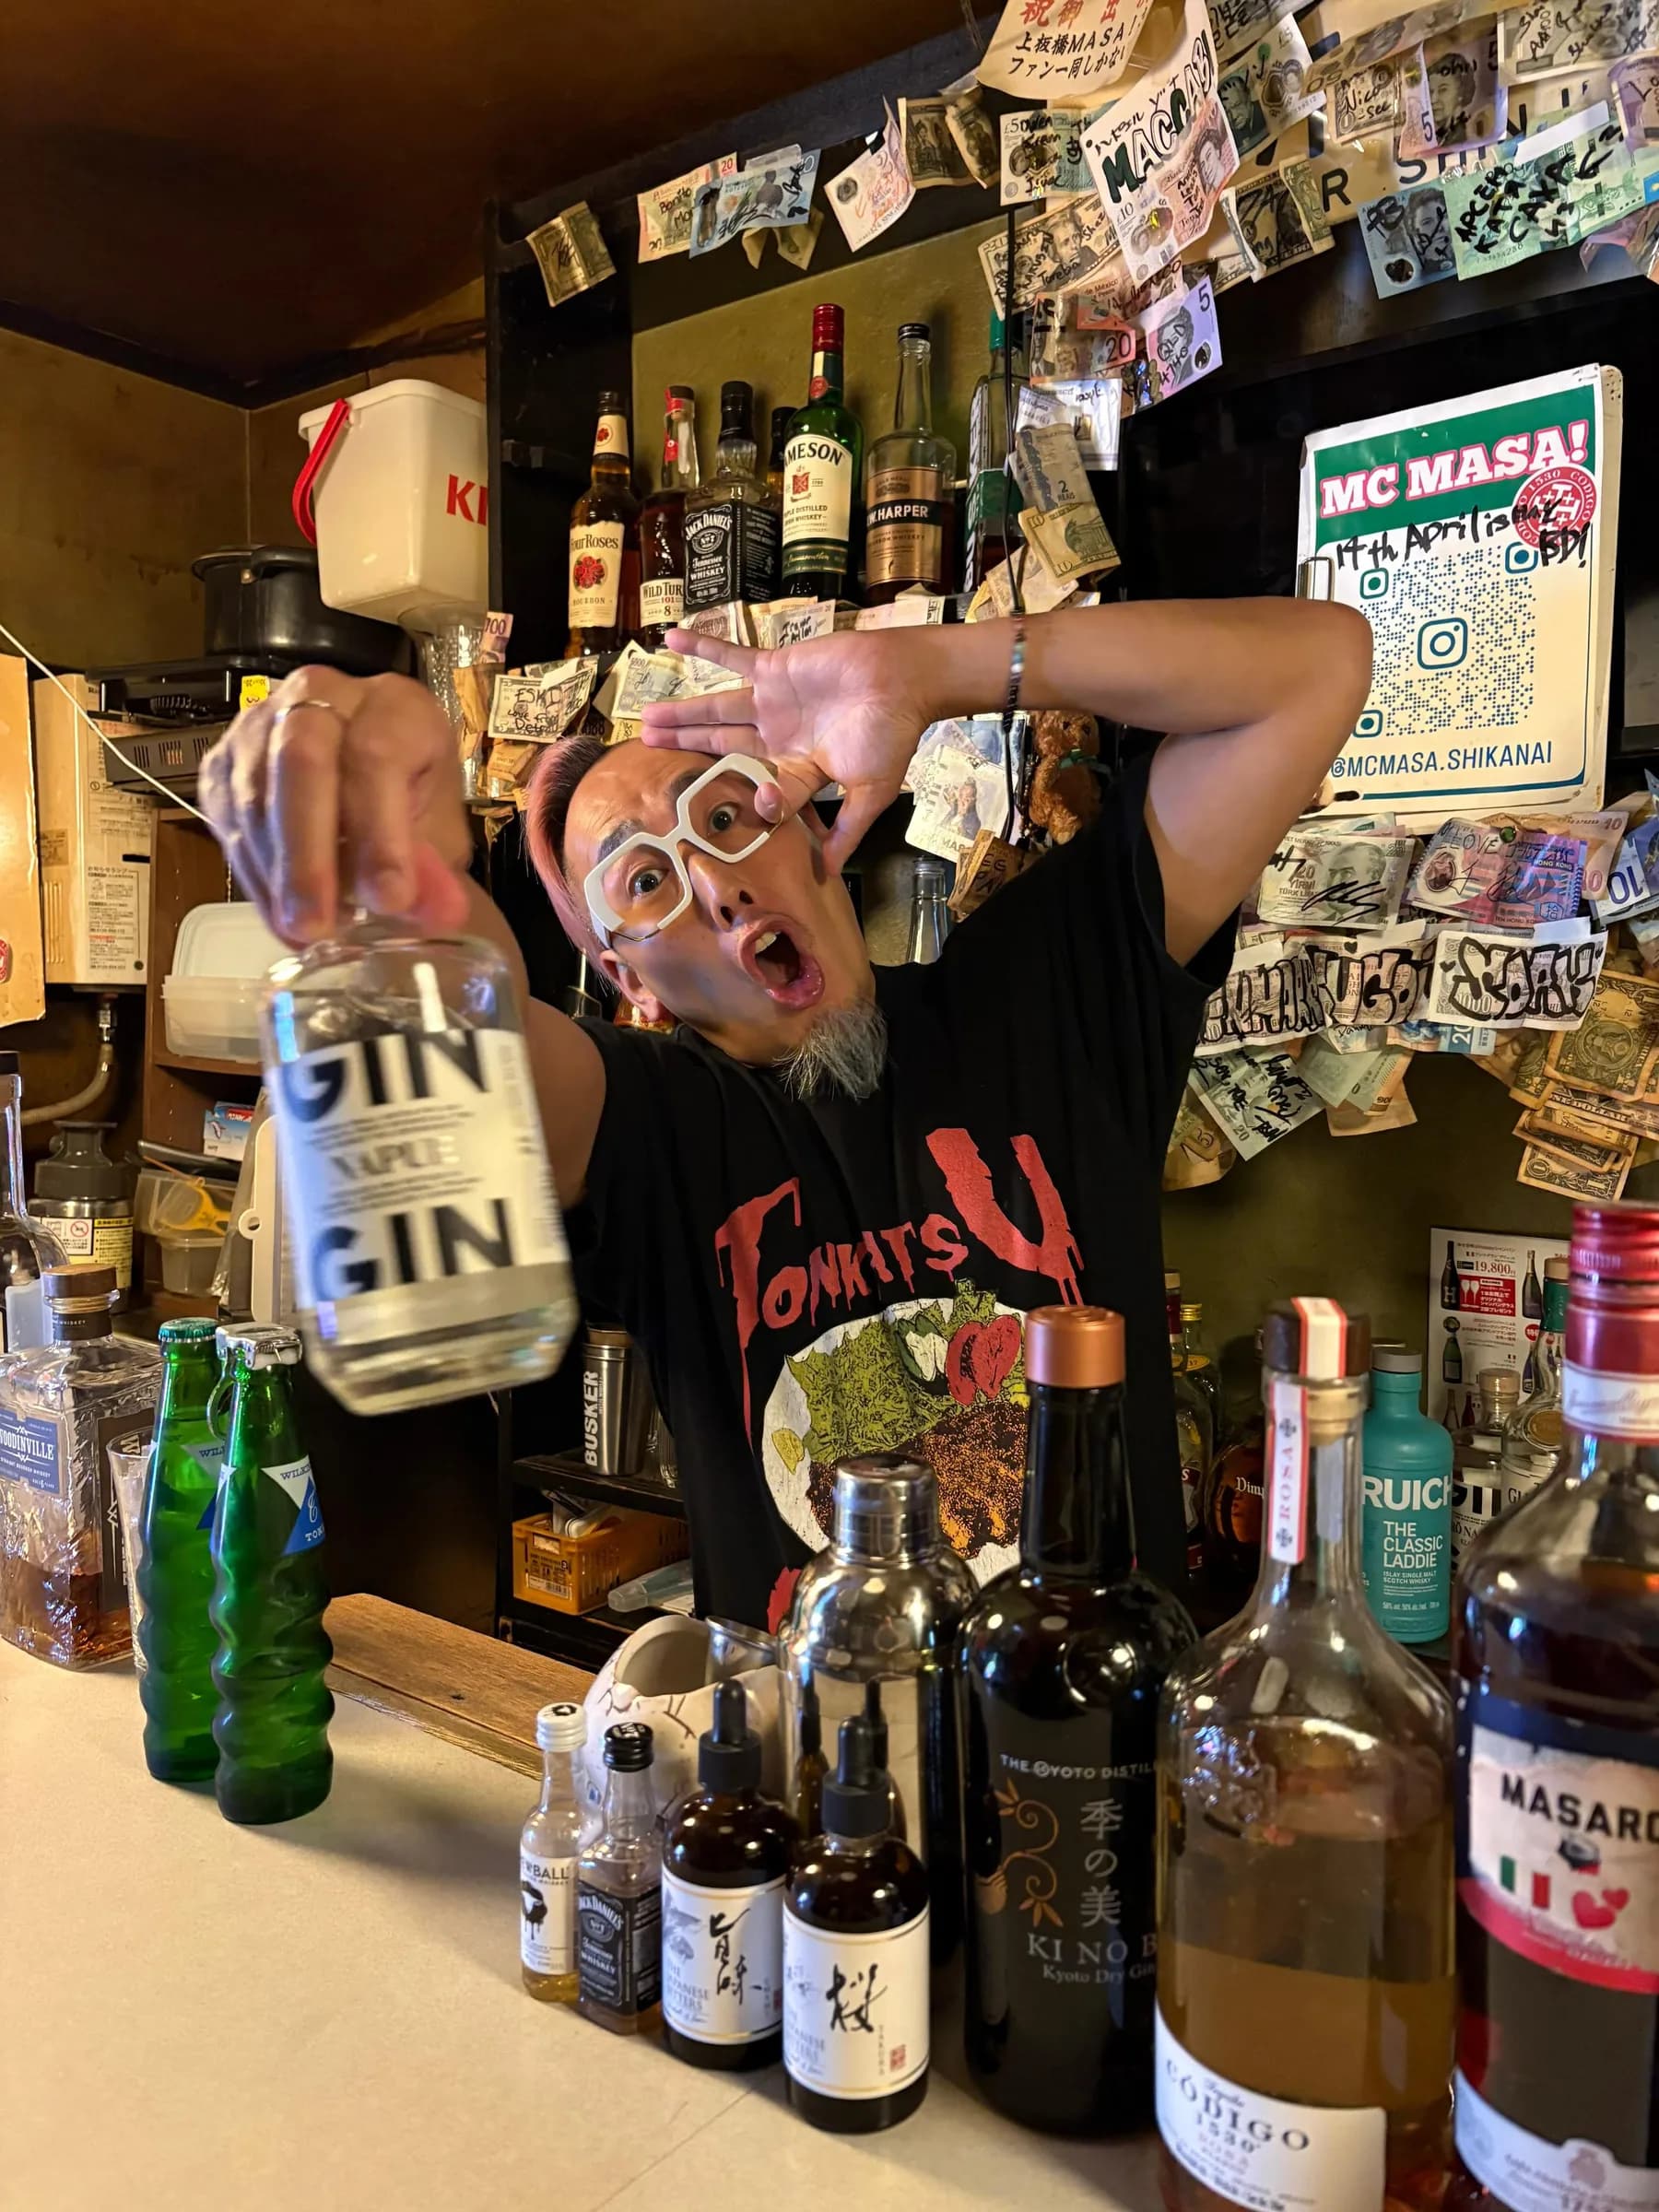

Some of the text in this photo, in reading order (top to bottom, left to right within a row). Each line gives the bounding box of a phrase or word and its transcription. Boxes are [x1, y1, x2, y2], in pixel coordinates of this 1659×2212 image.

[1198, 282, 1209, 312] 5
[1105, 333, 1132, 363] 20
[1320, 419, 1589, 518] MC MASA!
[1529, 469, 1560, 491] 1530
[1057, 480, 1068, 494] 2
[585, 534, 619, 550] Roses
[1405, 505, 1479, 562] April
[1486, 509, 1509, 537] is
[690, 566, 724, 582] WHISKEY
[664, 606, 671, 618] 8
[1330, 740, 1553, 779] @MCMASA.SHIKANAI
[283, 1030, 491, 1124] GIN
[312, 1198, 514, 1301] GIN
[583, 1371, 599, 1466] BUSKER
[1382, 1521, 1417, 1536] THE
[1383, 1535, 1443, 1553] CLASSIC
[1383, 1552, 1437, 1569] LADDIE
[1000, 1753, 1030, 1773] THE
[1079, 1797, 1124, 1928] 季の美
[1028, 1932, 1064, 1963] KI
[1043, 1963, 1090, 1984] Kyoto
[1095, 1967, 1124, 1985] Dry
